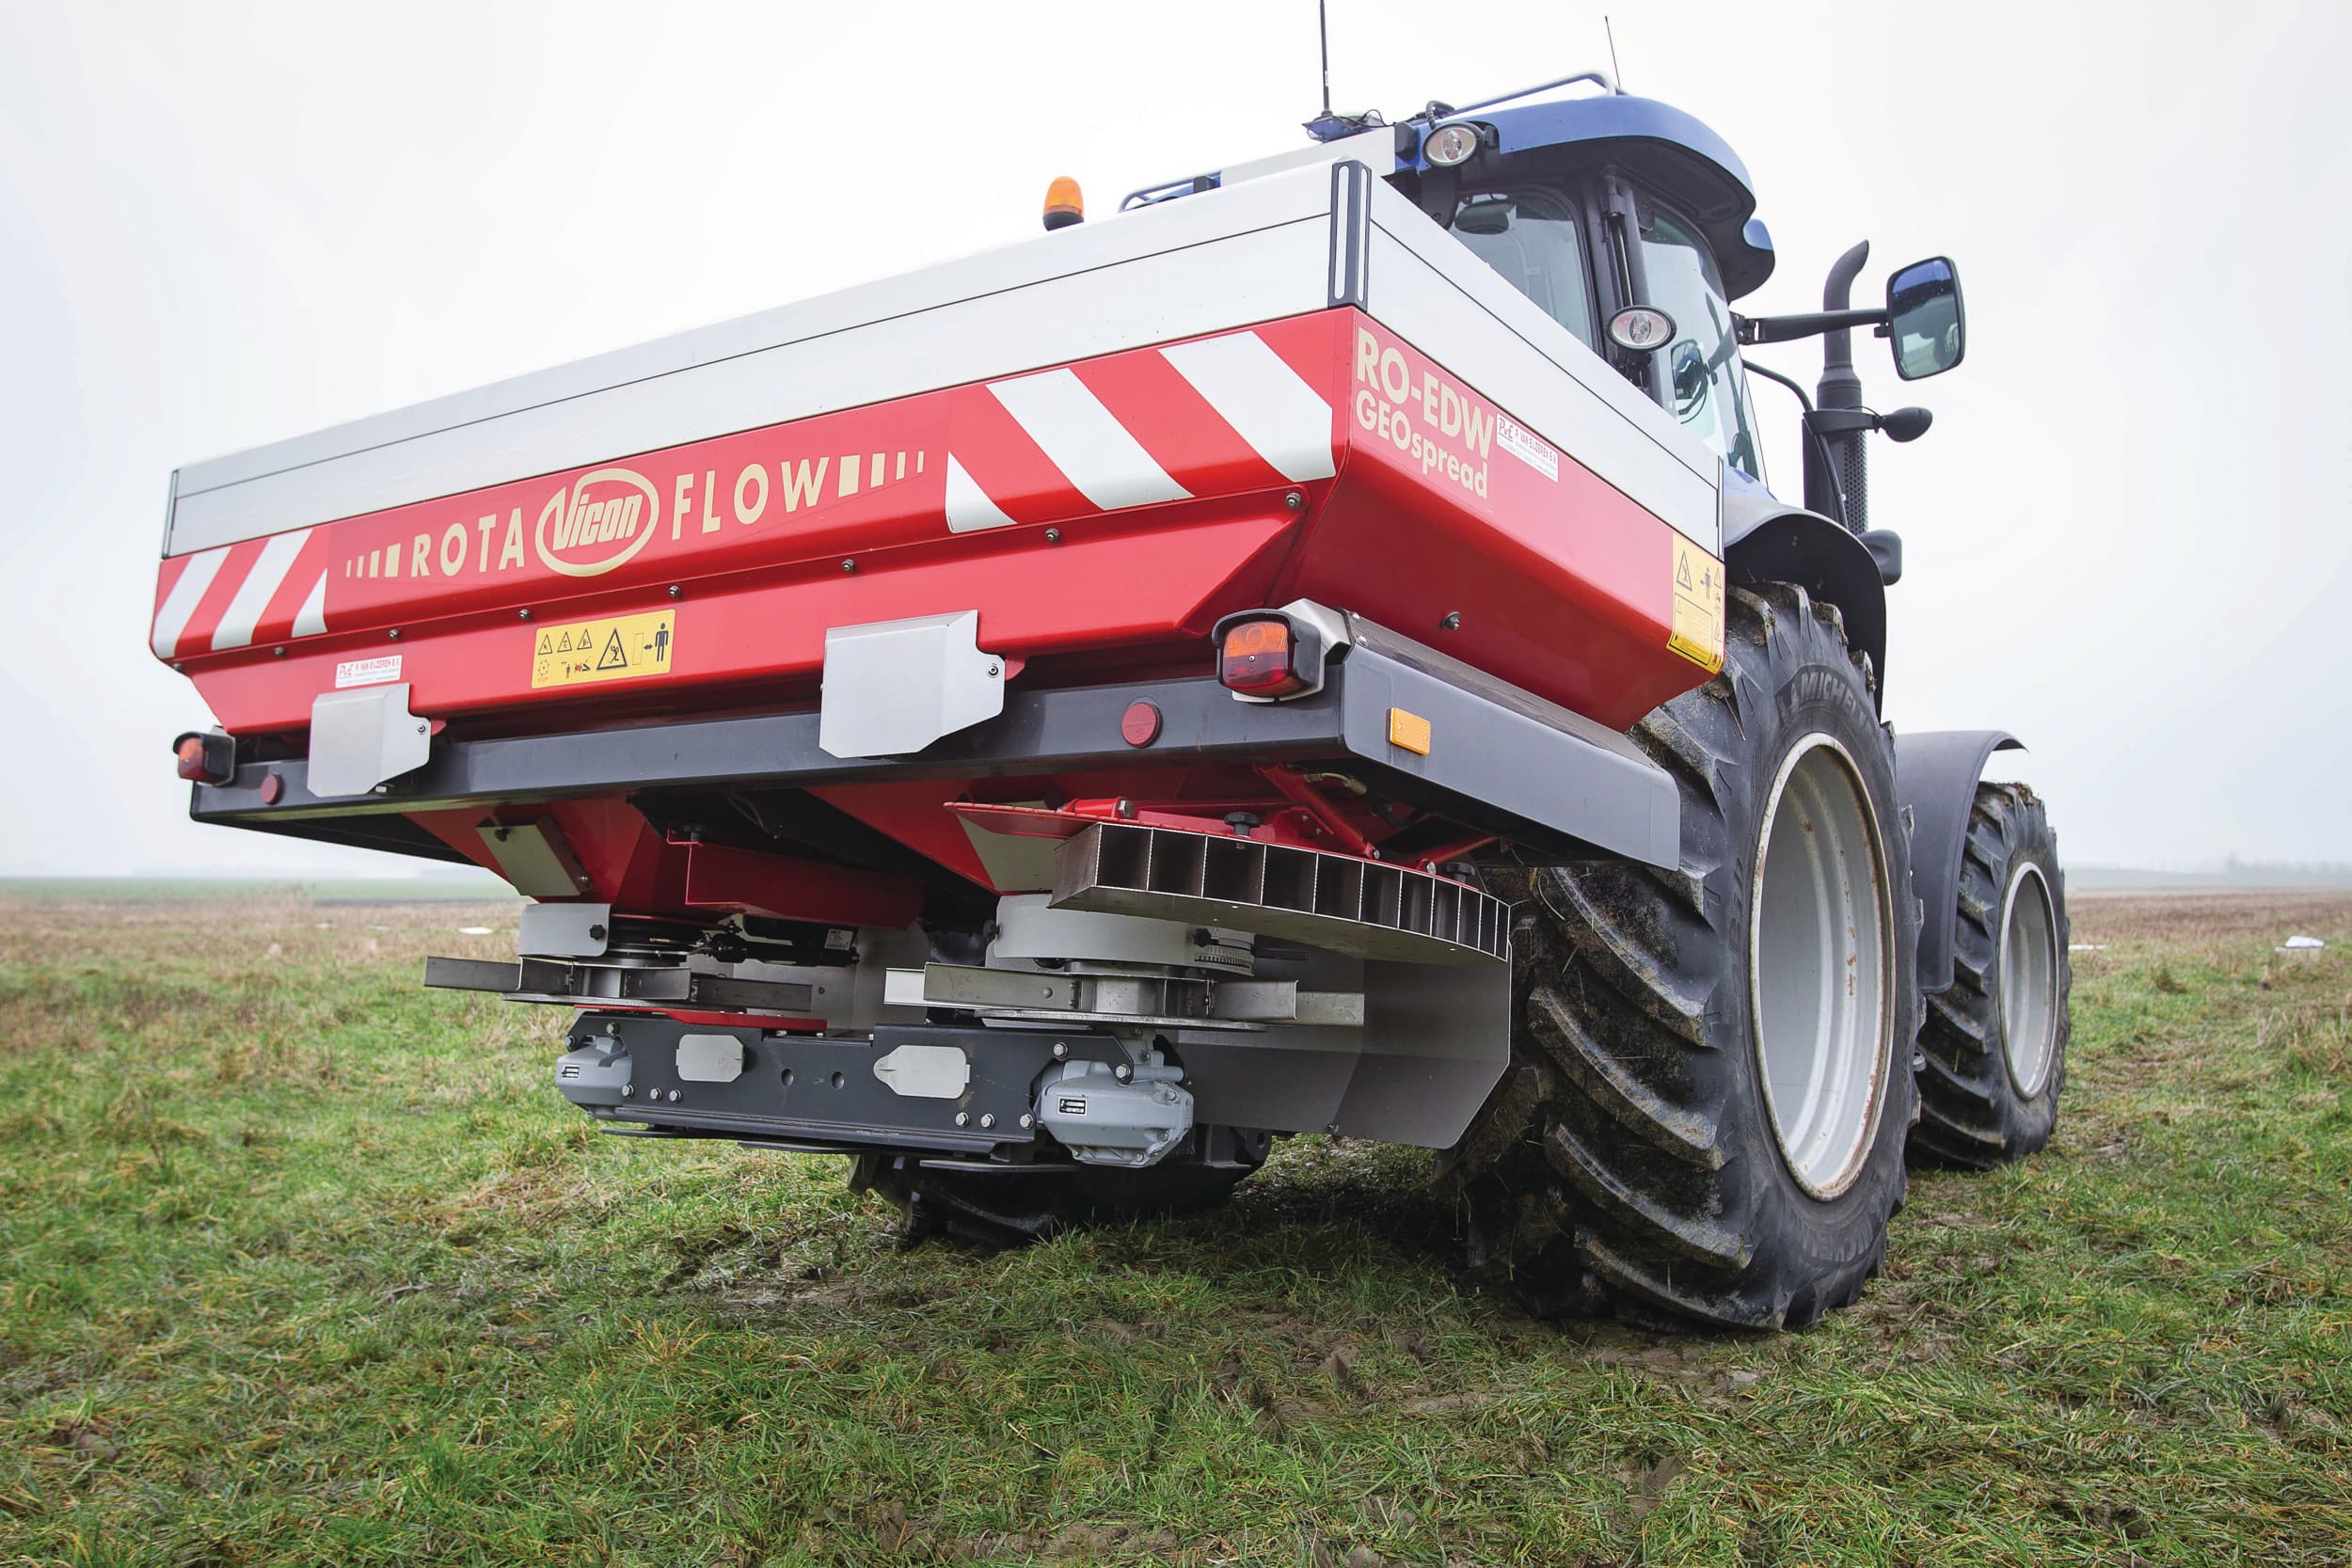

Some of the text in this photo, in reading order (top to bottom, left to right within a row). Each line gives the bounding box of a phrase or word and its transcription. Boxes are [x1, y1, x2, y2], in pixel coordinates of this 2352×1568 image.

[1357, 325, 1494, 460] RO-EDW
[1356, 389, 1487, 499] GEOspread
[411, 507, 525, 578] ROTA
[541, 472, 653, 565] Vicon
[672, 456, 830, 541] FLOW
